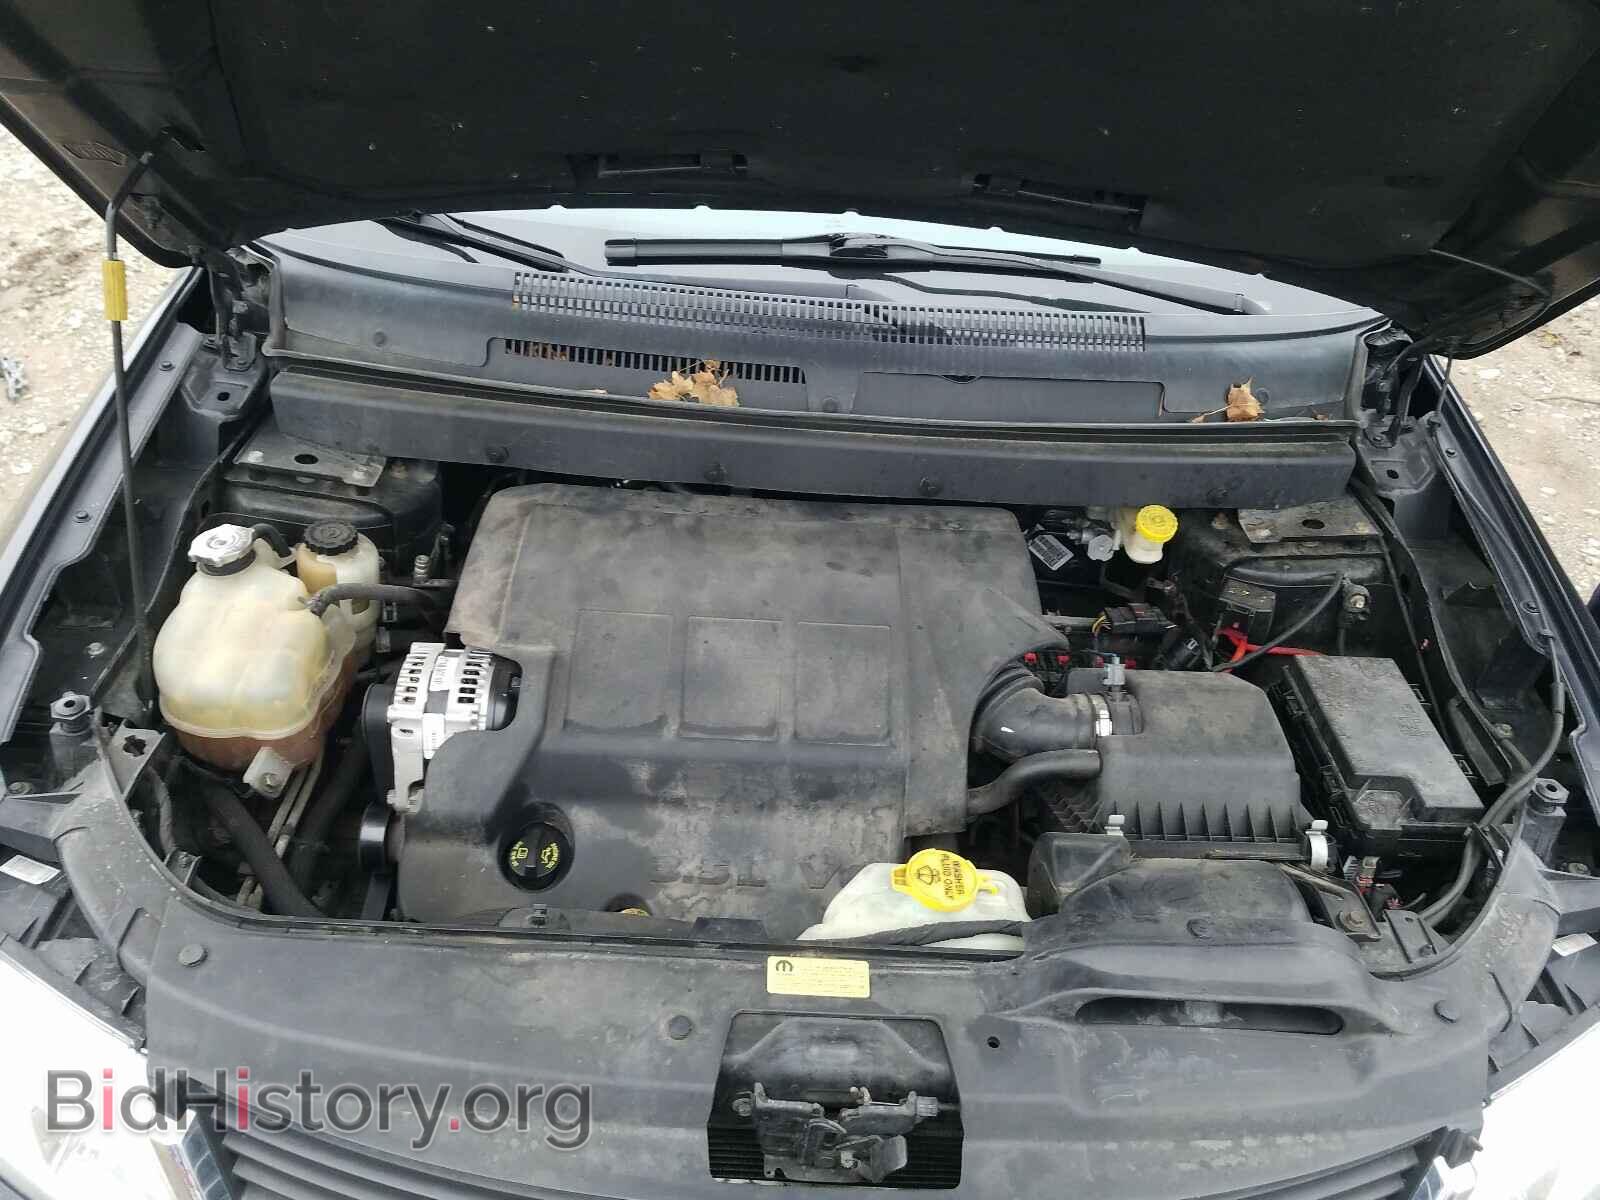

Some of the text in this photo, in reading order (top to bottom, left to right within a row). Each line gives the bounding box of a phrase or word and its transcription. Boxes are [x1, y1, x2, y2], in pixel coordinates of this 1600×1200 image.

[940, 853, 954, 900] FLUID ONLY
[952, 860, 965, 895] WASHER
